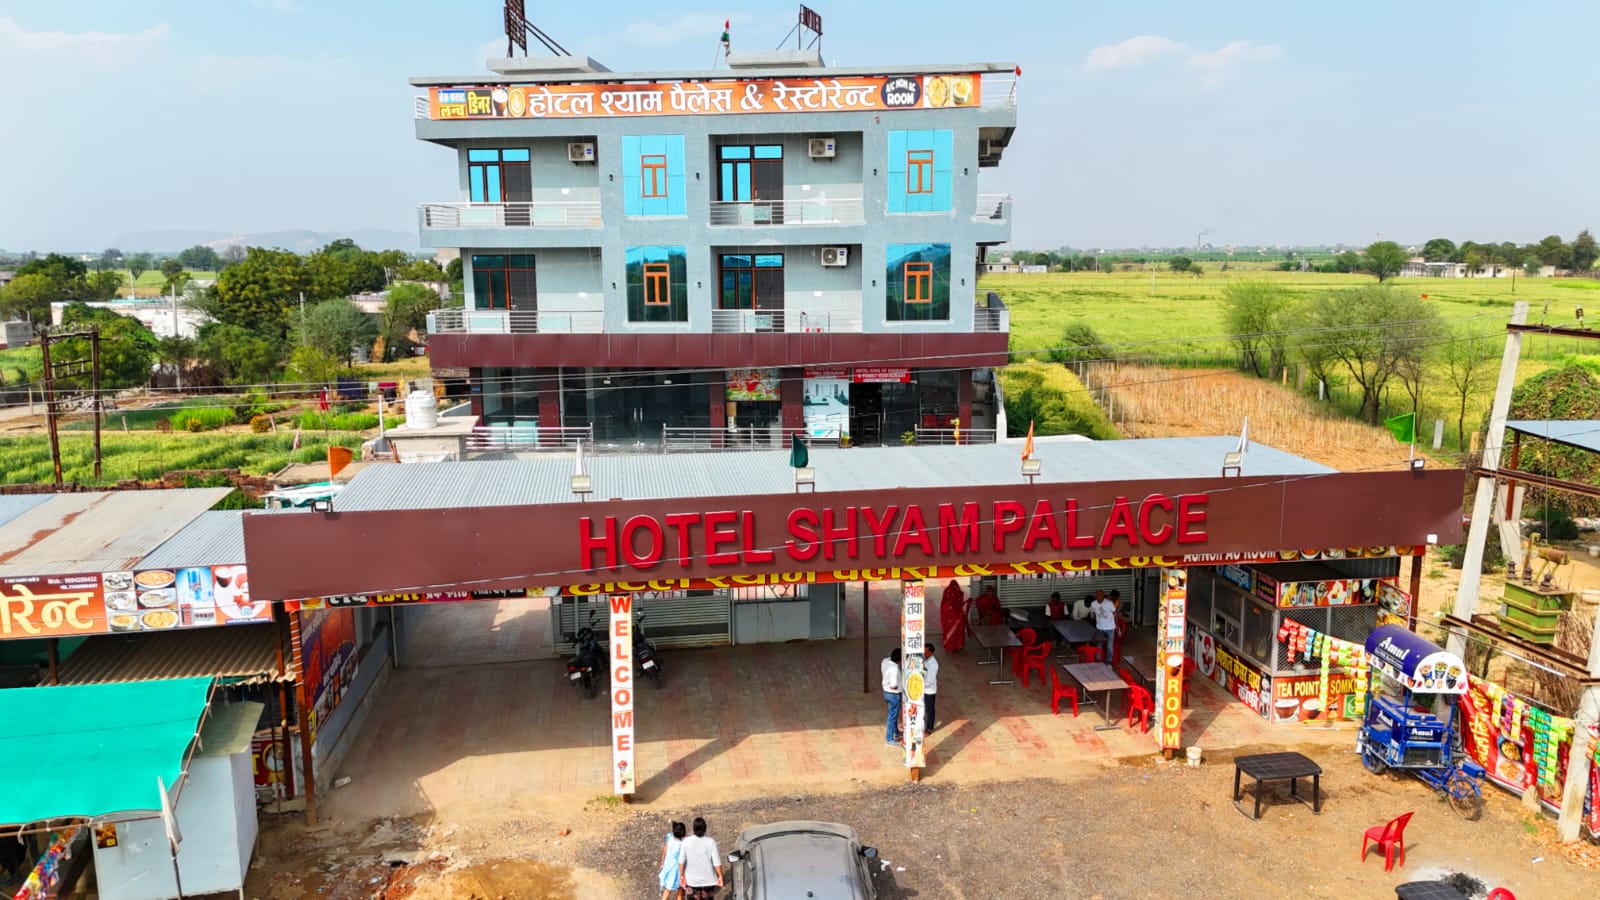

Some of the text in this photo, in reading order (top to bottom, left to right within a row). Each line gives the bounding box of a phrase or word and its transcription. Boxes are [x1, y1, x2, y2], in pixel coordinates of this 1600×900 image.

[529, 80, 878, 116] होटल श्याम पैलेस & रेस्टोरेन्ट
[886, 92, 915, 105] ROOM
[579, 494, 1208, 572] HOTEL SHYAM PALACE
[1379, 636, 1410, 660] Amul
[610, 597, 632, 751] WELCOME
[1277, 682, 1293, 697] TEA
[1294, 680, 1320, 696] POINT
[1164, 679, 1179, 746] ROOM
[1411, 728, 1433, 736] Amul
